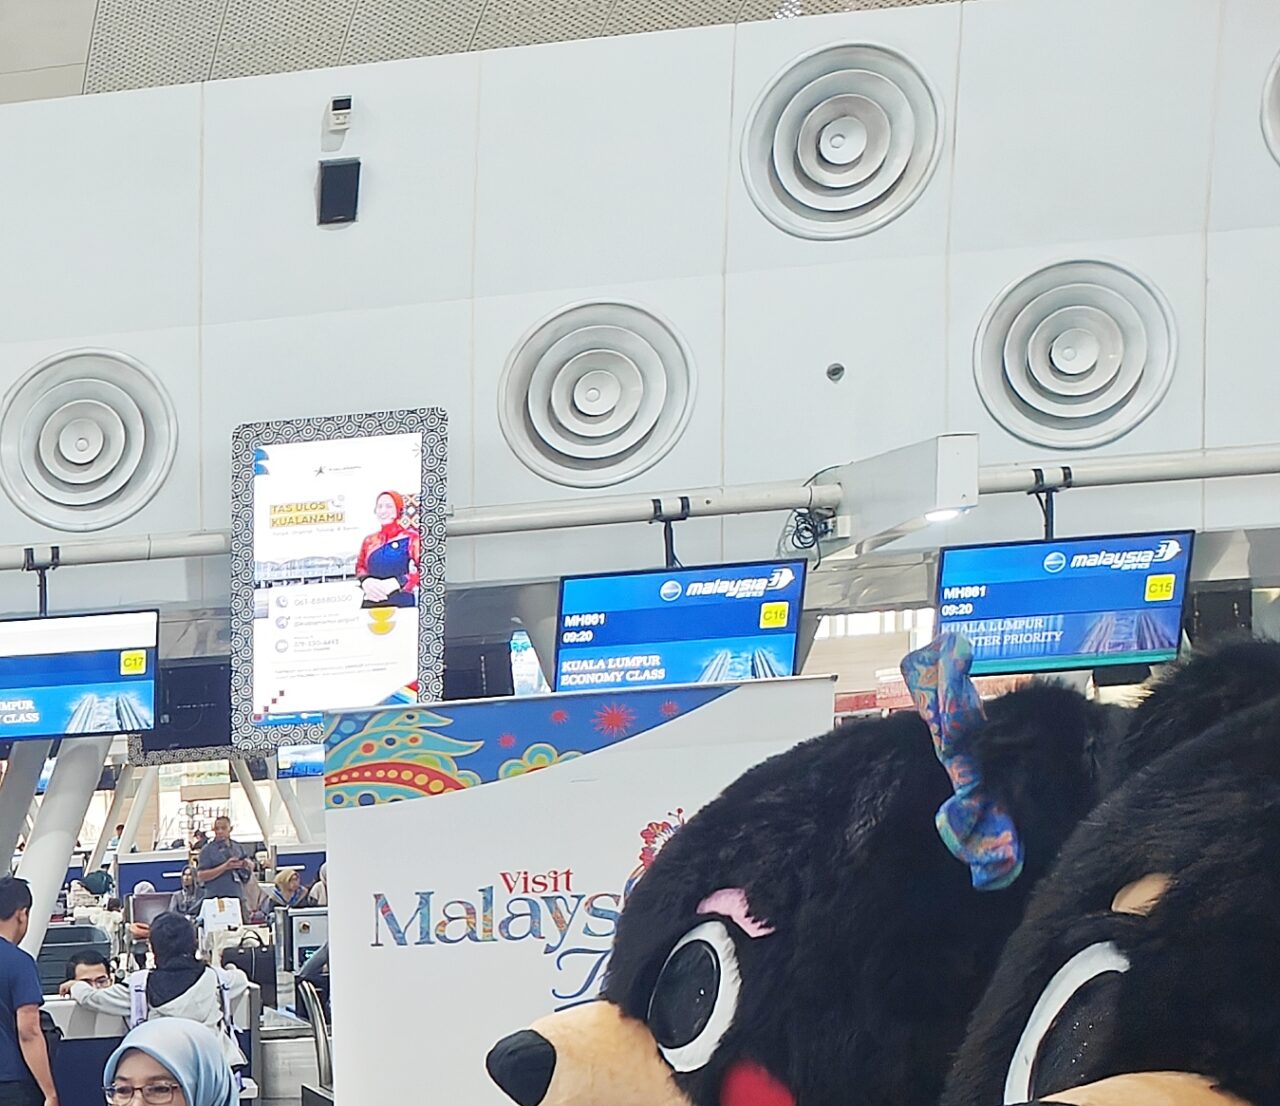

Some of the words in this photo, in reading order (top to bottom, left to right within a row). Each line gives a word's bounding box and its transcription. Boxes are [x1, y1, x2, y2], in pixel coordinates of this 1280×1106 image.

[296, 502, 326, 512] ULOS
[271, 513, 344, 527] KUALANAMU
[1070, 550, 1154, 570] malaysia
[685, 578, 768, 597] malaysia
[1148, 582, 1172, 594] C15
[941, 603, 973, 616] 09:20
[989, 617, 1044, 631] LUMPUR
[969, 635, 1002, 648] NTER
[1003, 631, 1064, 645] PRIORITY
[123, 656, 144, 668] C17
[561, 657, 606, 672] KUALA
[607, 654, 661, 670] LUMPUR
[560, 671, 624, 686] ECONOMY
[625, 668, 666, 682] CLASS
[3, 712, 40, 724] CLASS
[499, 868, 574, 895] Visit
[370, 885, 623, 954] Malays
